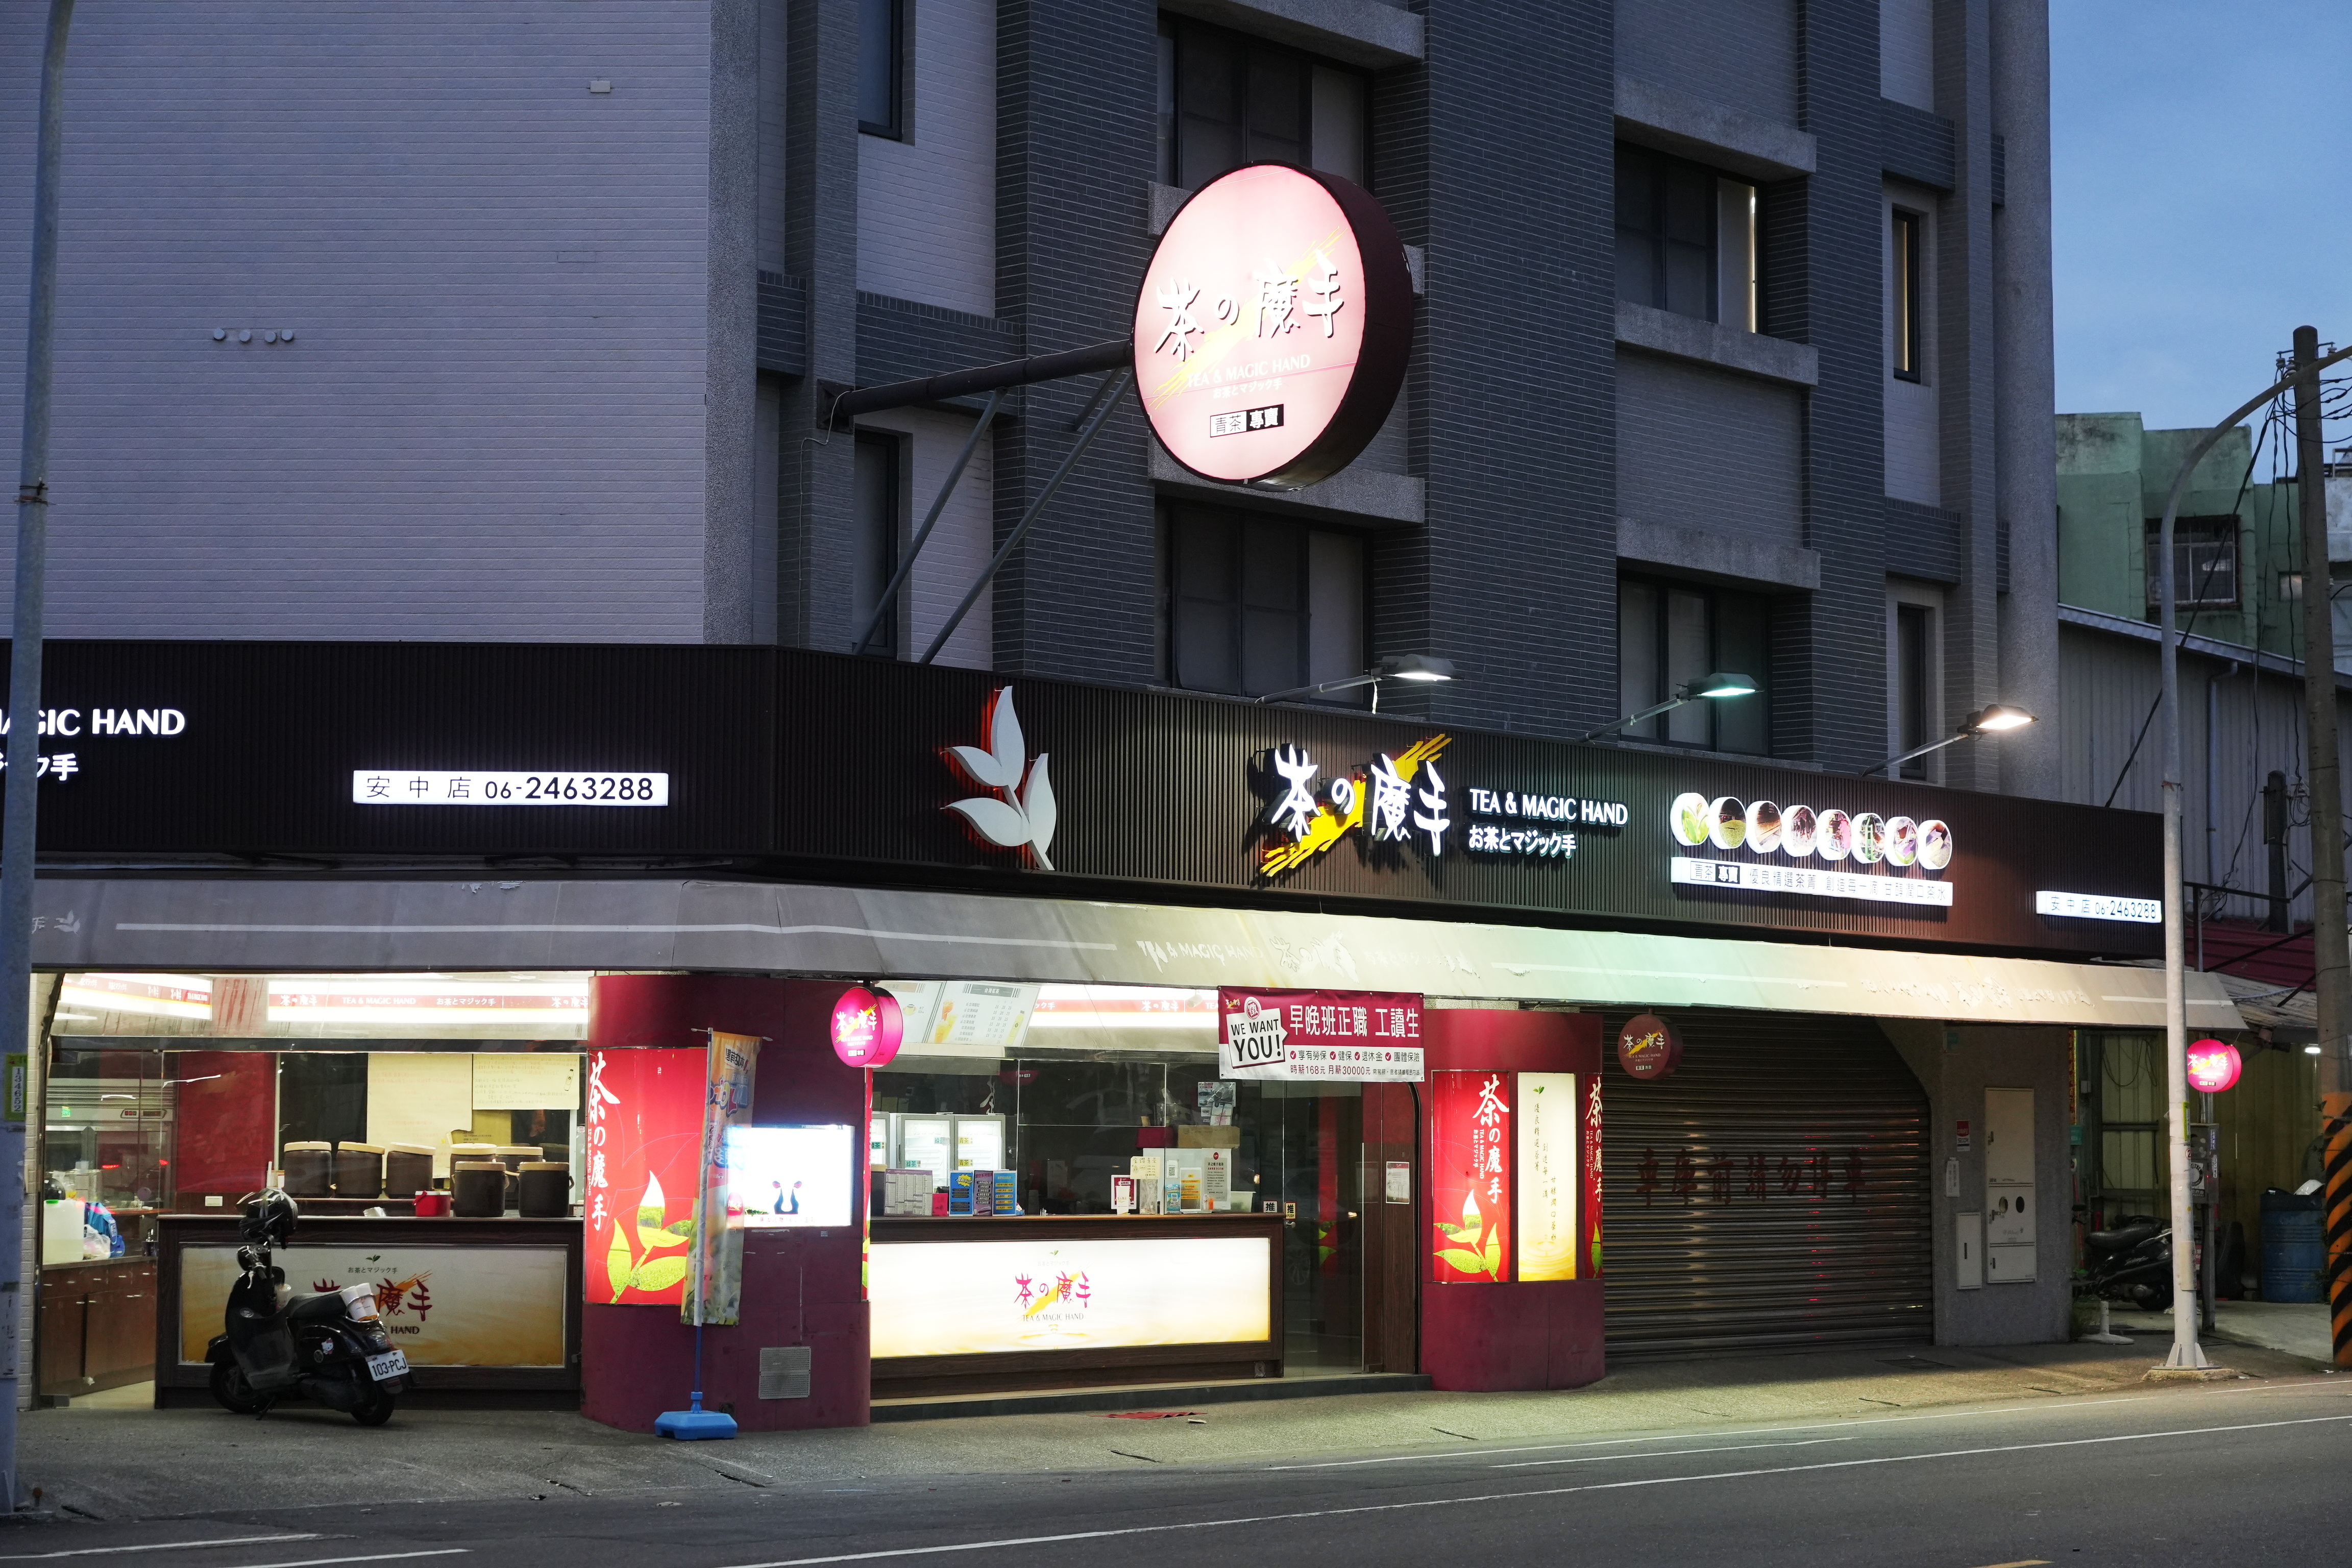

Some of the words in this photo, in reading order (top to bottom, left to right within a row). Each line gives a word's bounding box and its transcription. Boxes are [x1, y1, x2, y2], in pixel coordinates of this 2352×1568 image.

[1154, 249, 1344, 362] 茶の魔手
[1187, 372, 1210, 387] TEA
[1213, 371, 1222, 383] &
[1226, 363, 1268, 381] MAGIC
[1272, 354, 1311, 373] HAND
[1213, 378, 1283, 399] お茶とマジック手
[92, 708, 186, 736] HAND
[366, 776, 472, 799] 安中店
[485, 776, 654, 800] 06-2463288
[1271, 743, 1451, 857] 茶の魔手
[1469, 787, 1501, 814] TEA
[1505, 792, 1518, 815] &
[1523, 794, 1577, 822] MAGIC
[1581, 800, 1628, 826] HAND
[1469, 824, 1577, 860] お茶とマジック手
[2051, 895, 2090, 914] 安中店
[2095, 900, 2157, 919] 06-2463288
[366, 997, 391, 1005] MAGIC
[393, 997, 416, 1005] HAND
[436, 998, 497, 1007] お茶とマジック手
[836, 1009, 877, 1033] 茶の魔手
[1231, 1023, 1246, 1037] WE
[1250, 1018, 1280, 1034] WANT
[1289, 1004, 1368, 1037] 早晚班正職
[1375, 1008, 1420, 1038] 工讀生
[1233, 1034, 1281, 1062] YOU!
[1623, 1032, 1665, 1051] 茶の魔手
[1298, 1049, 1327, 1063] 享有勞保
[1338, 1050, 1353, 1062] 健保
[1362, 1051, 1383, 1062] 退休金
[1290, 1065, 1326, 1075] 時薪168元
[1328, 1065, 1371, 1075] 月薪30000元
[589, 1051, 621, 1231] 茶の魔手
[1472, 1074, 1510, 1204] 茶の魔手
[1585, 1076, 1603, 1203] 茶の魔手
[1266, 1203, 1275, 1211] 推
[1287, 1204, 1294, 1213] 推
[348, 1266, 398, 1275] お茶とマジック手
[1014, 1270, 1091, 1309] 茶の魔手
[390, 1326, 420, 1335] HAND
[371, 1357, 407, 1378] 103-PCJ
